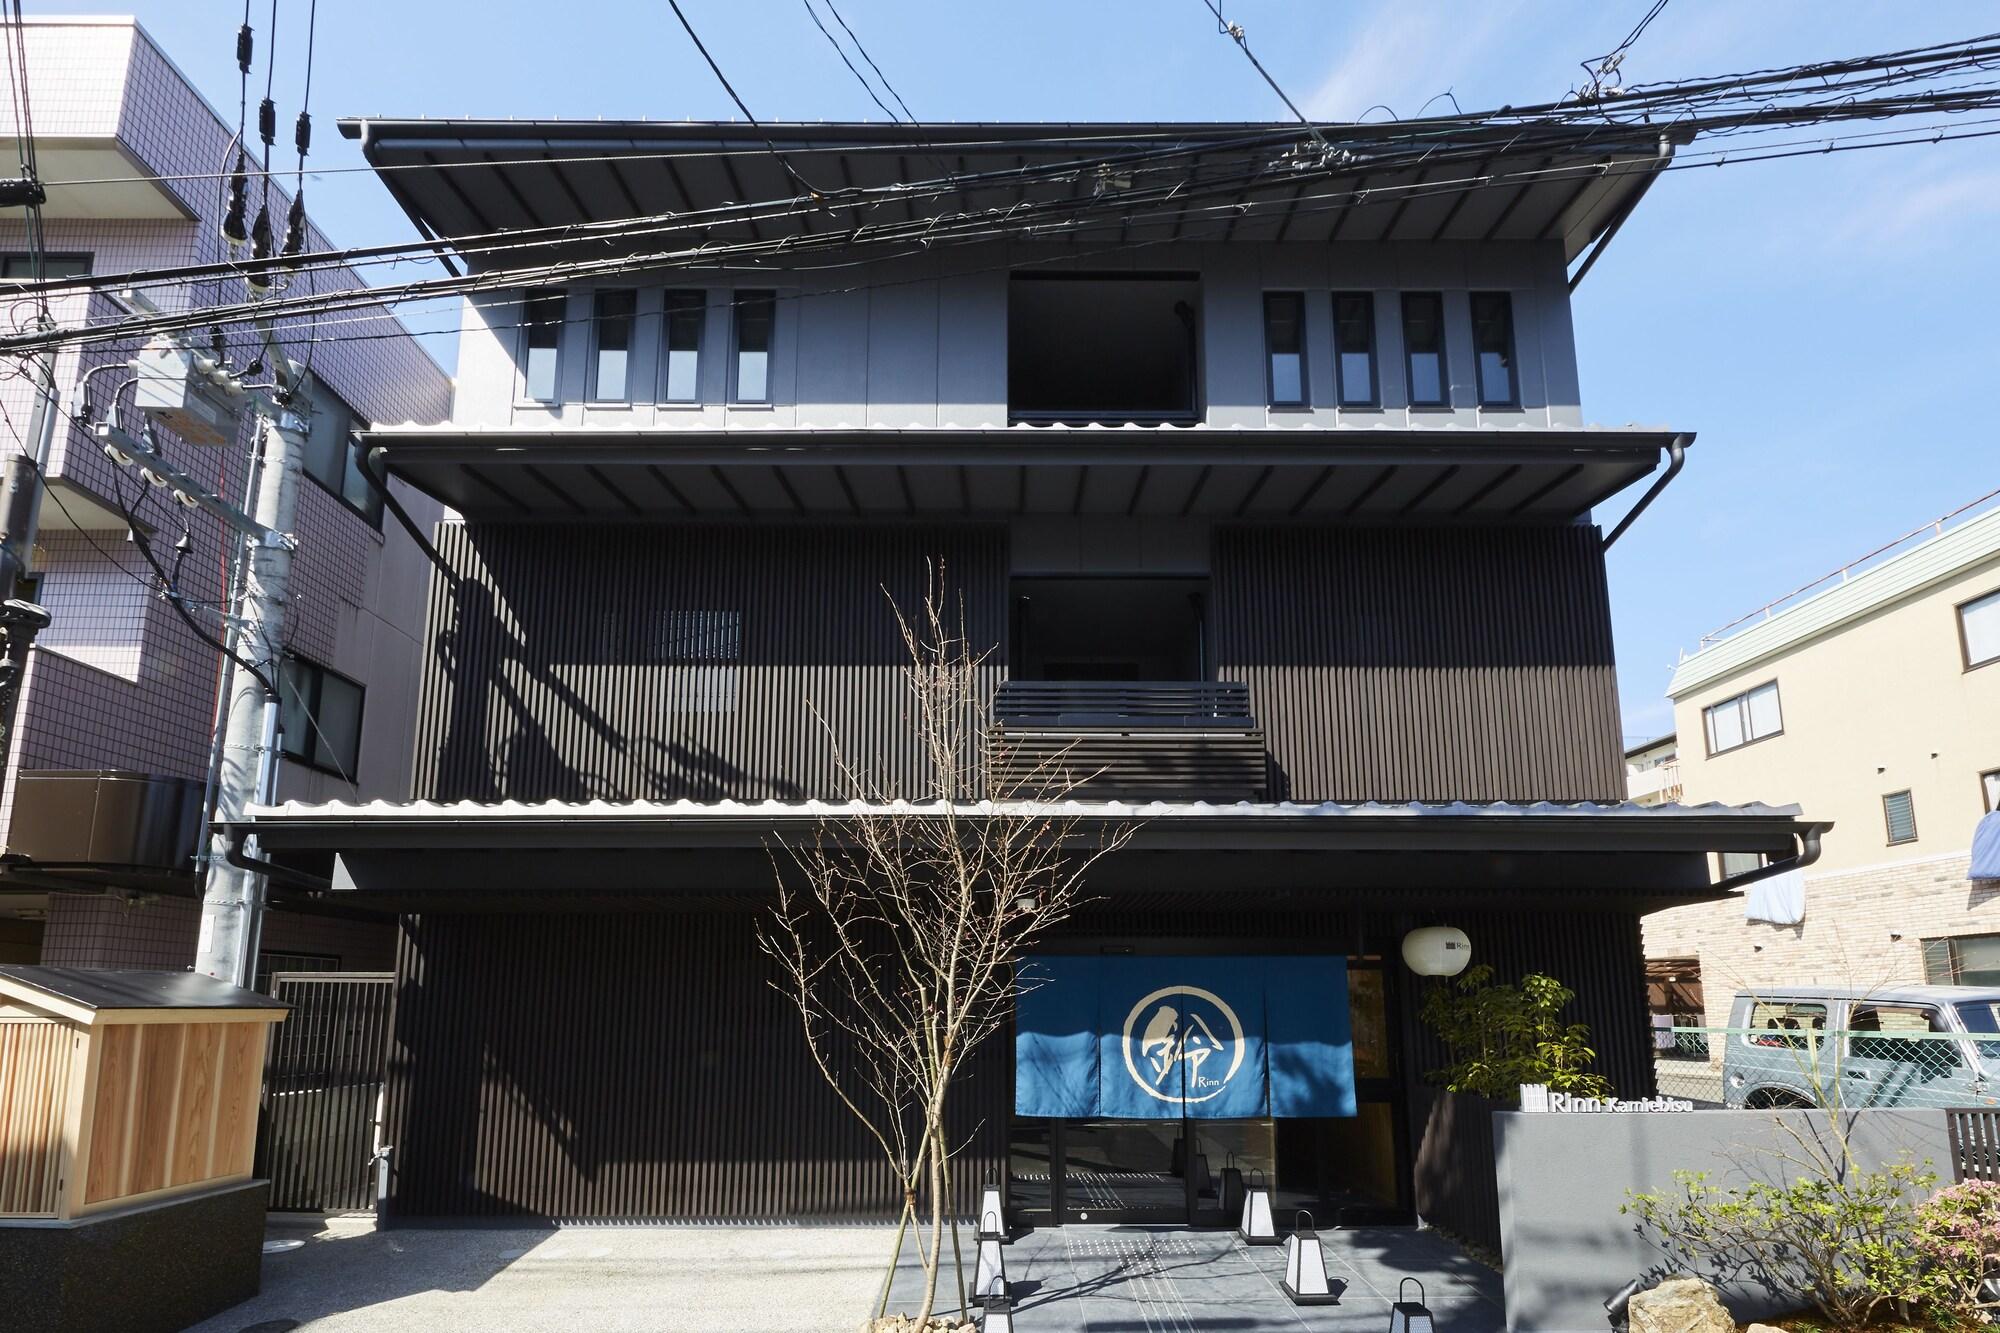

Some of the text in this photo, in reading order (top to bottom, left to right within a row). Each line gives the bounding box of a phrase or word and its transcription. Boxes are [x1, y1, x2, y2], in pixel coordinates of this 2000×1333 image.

[1198, 1076, 1219, 1088] Rinn
[1548, 1092, 1694, 1113] Rinn Kamiebisu
